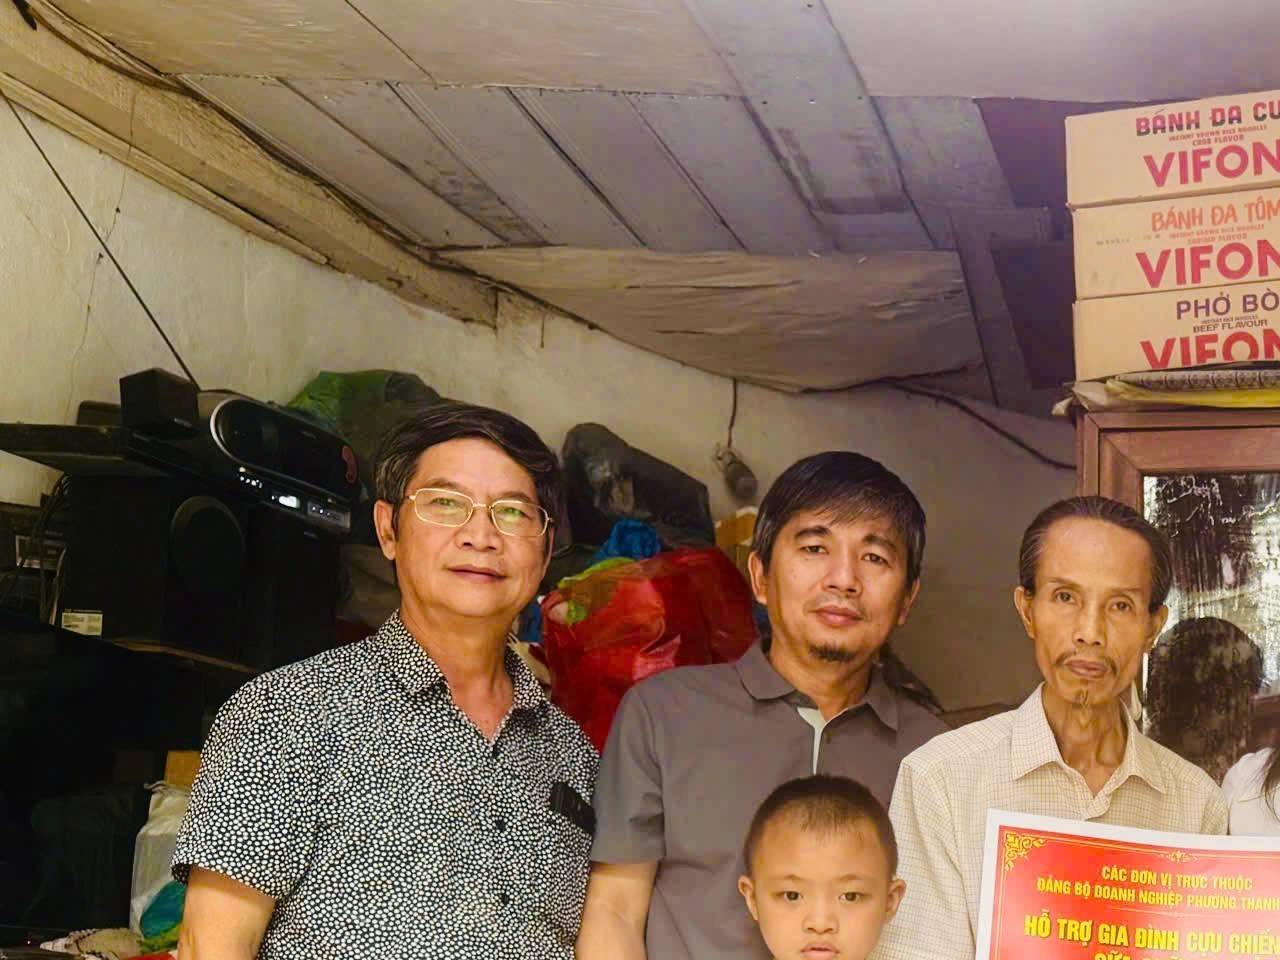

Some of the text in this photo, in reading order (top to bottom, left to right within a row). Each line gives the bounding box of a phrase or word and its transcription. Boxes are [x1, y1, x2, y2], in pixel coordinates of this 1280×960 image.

[1136, 109, 1200, 137] BÁNH
[1210, 105, 1243, 127] ĐA
[1152, 206, 1203, 232] BÁNH
[1211, 203, 1238, 225] ĐA
[1176, 288, 1280, 320] PHỞ BÒ
[1193, 318, 1268, 334] BEEF FLAVOUR
[1037, 874, 1071, 895] ĐẢNG
[1074, 880, 1091, 899] BỘ
[1094, 885, 1136, 902] DOANH
[1139, 890, 1183, 909] NGHIỆP
[1241, 897, 1280, 911] THANH
[1101, 865, 1127, 881] CÁC
[1131, 869, 1156, 885] ĐƠN
[1160, 873, 1172, 889] VỊ
[1024, 909, 1052, 938] HỖ
[1057, 918, 1093, 948] TRỢ
[1098, 923, 1130, 947] GIA
[1134, 924, 1180, 951] ĐÌNH
[1187, 929, 1224, 957] CỰU
[1230, 929, 1280, 955] CHIẾN
